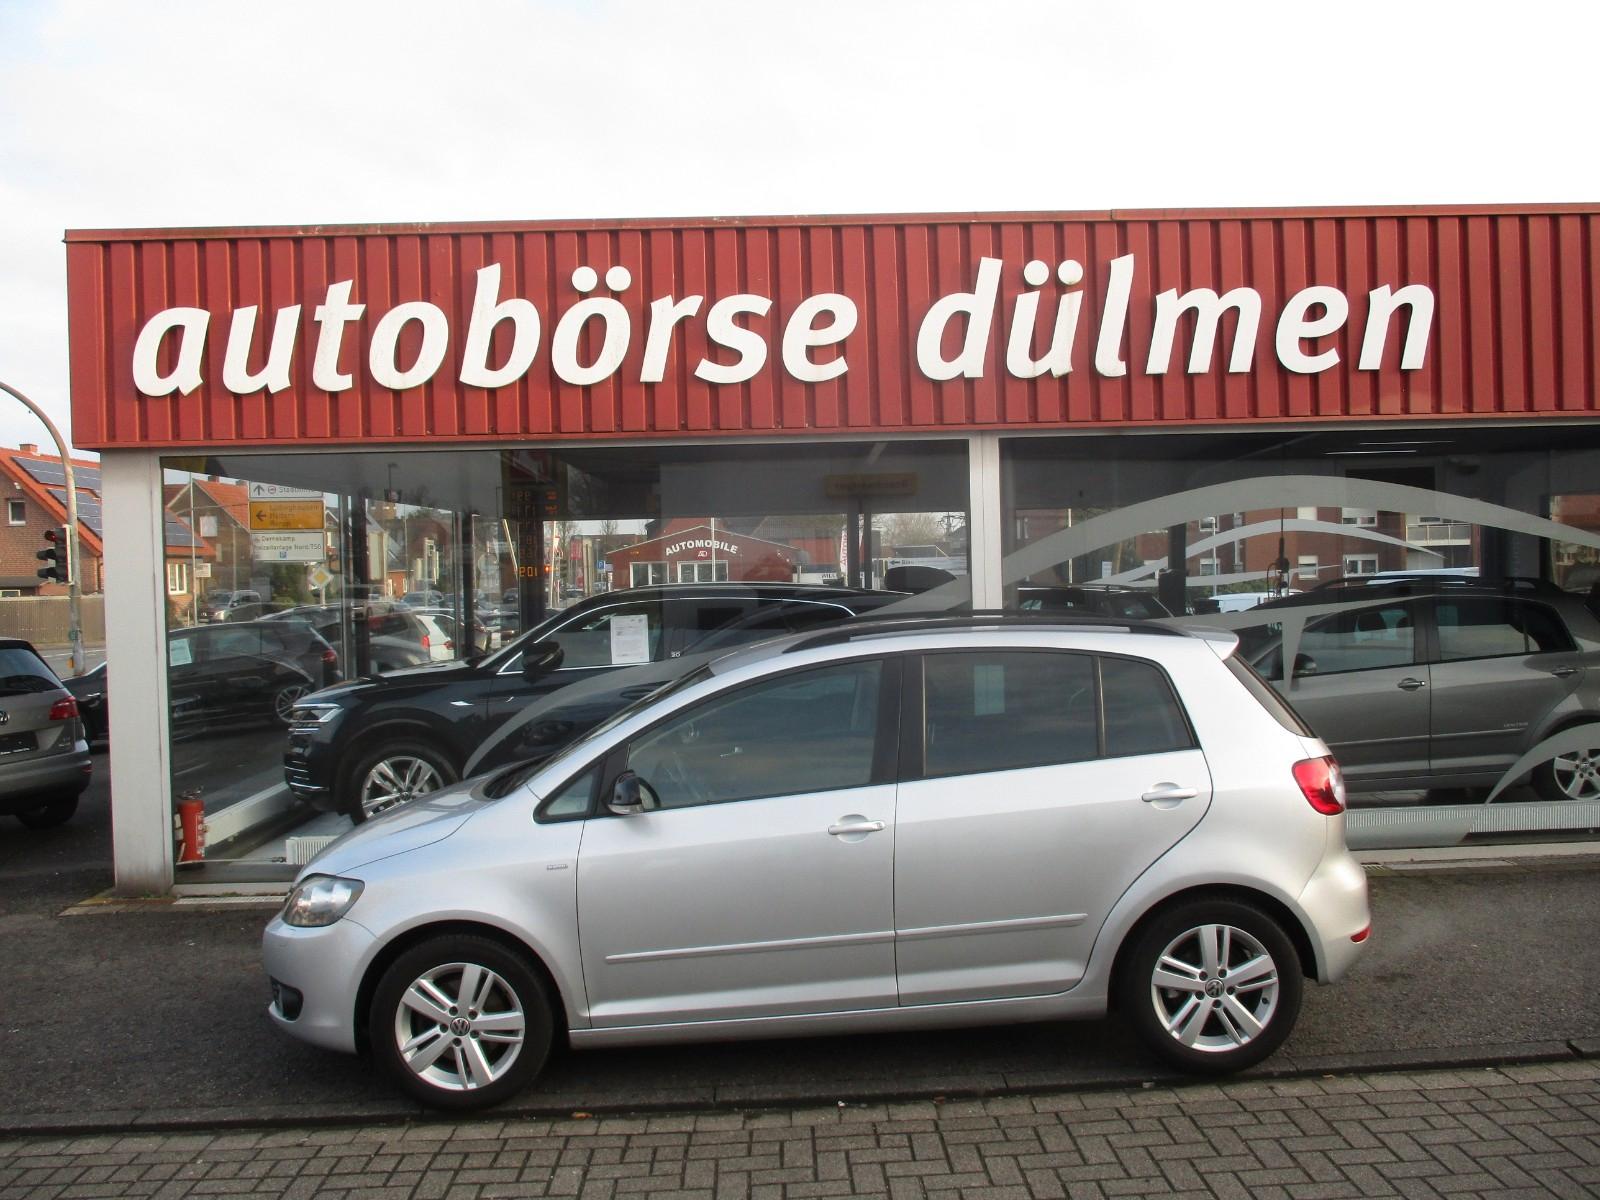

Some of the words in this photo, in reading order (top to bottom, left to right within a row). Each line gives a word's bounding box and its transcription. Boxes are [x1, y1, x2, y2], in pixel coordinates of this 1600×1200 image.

[131, 262, 859, 397] autobörse
[916, 252, 1436, 382] dülmen
[665, 539, 739, 556] AUTOMOBILE
